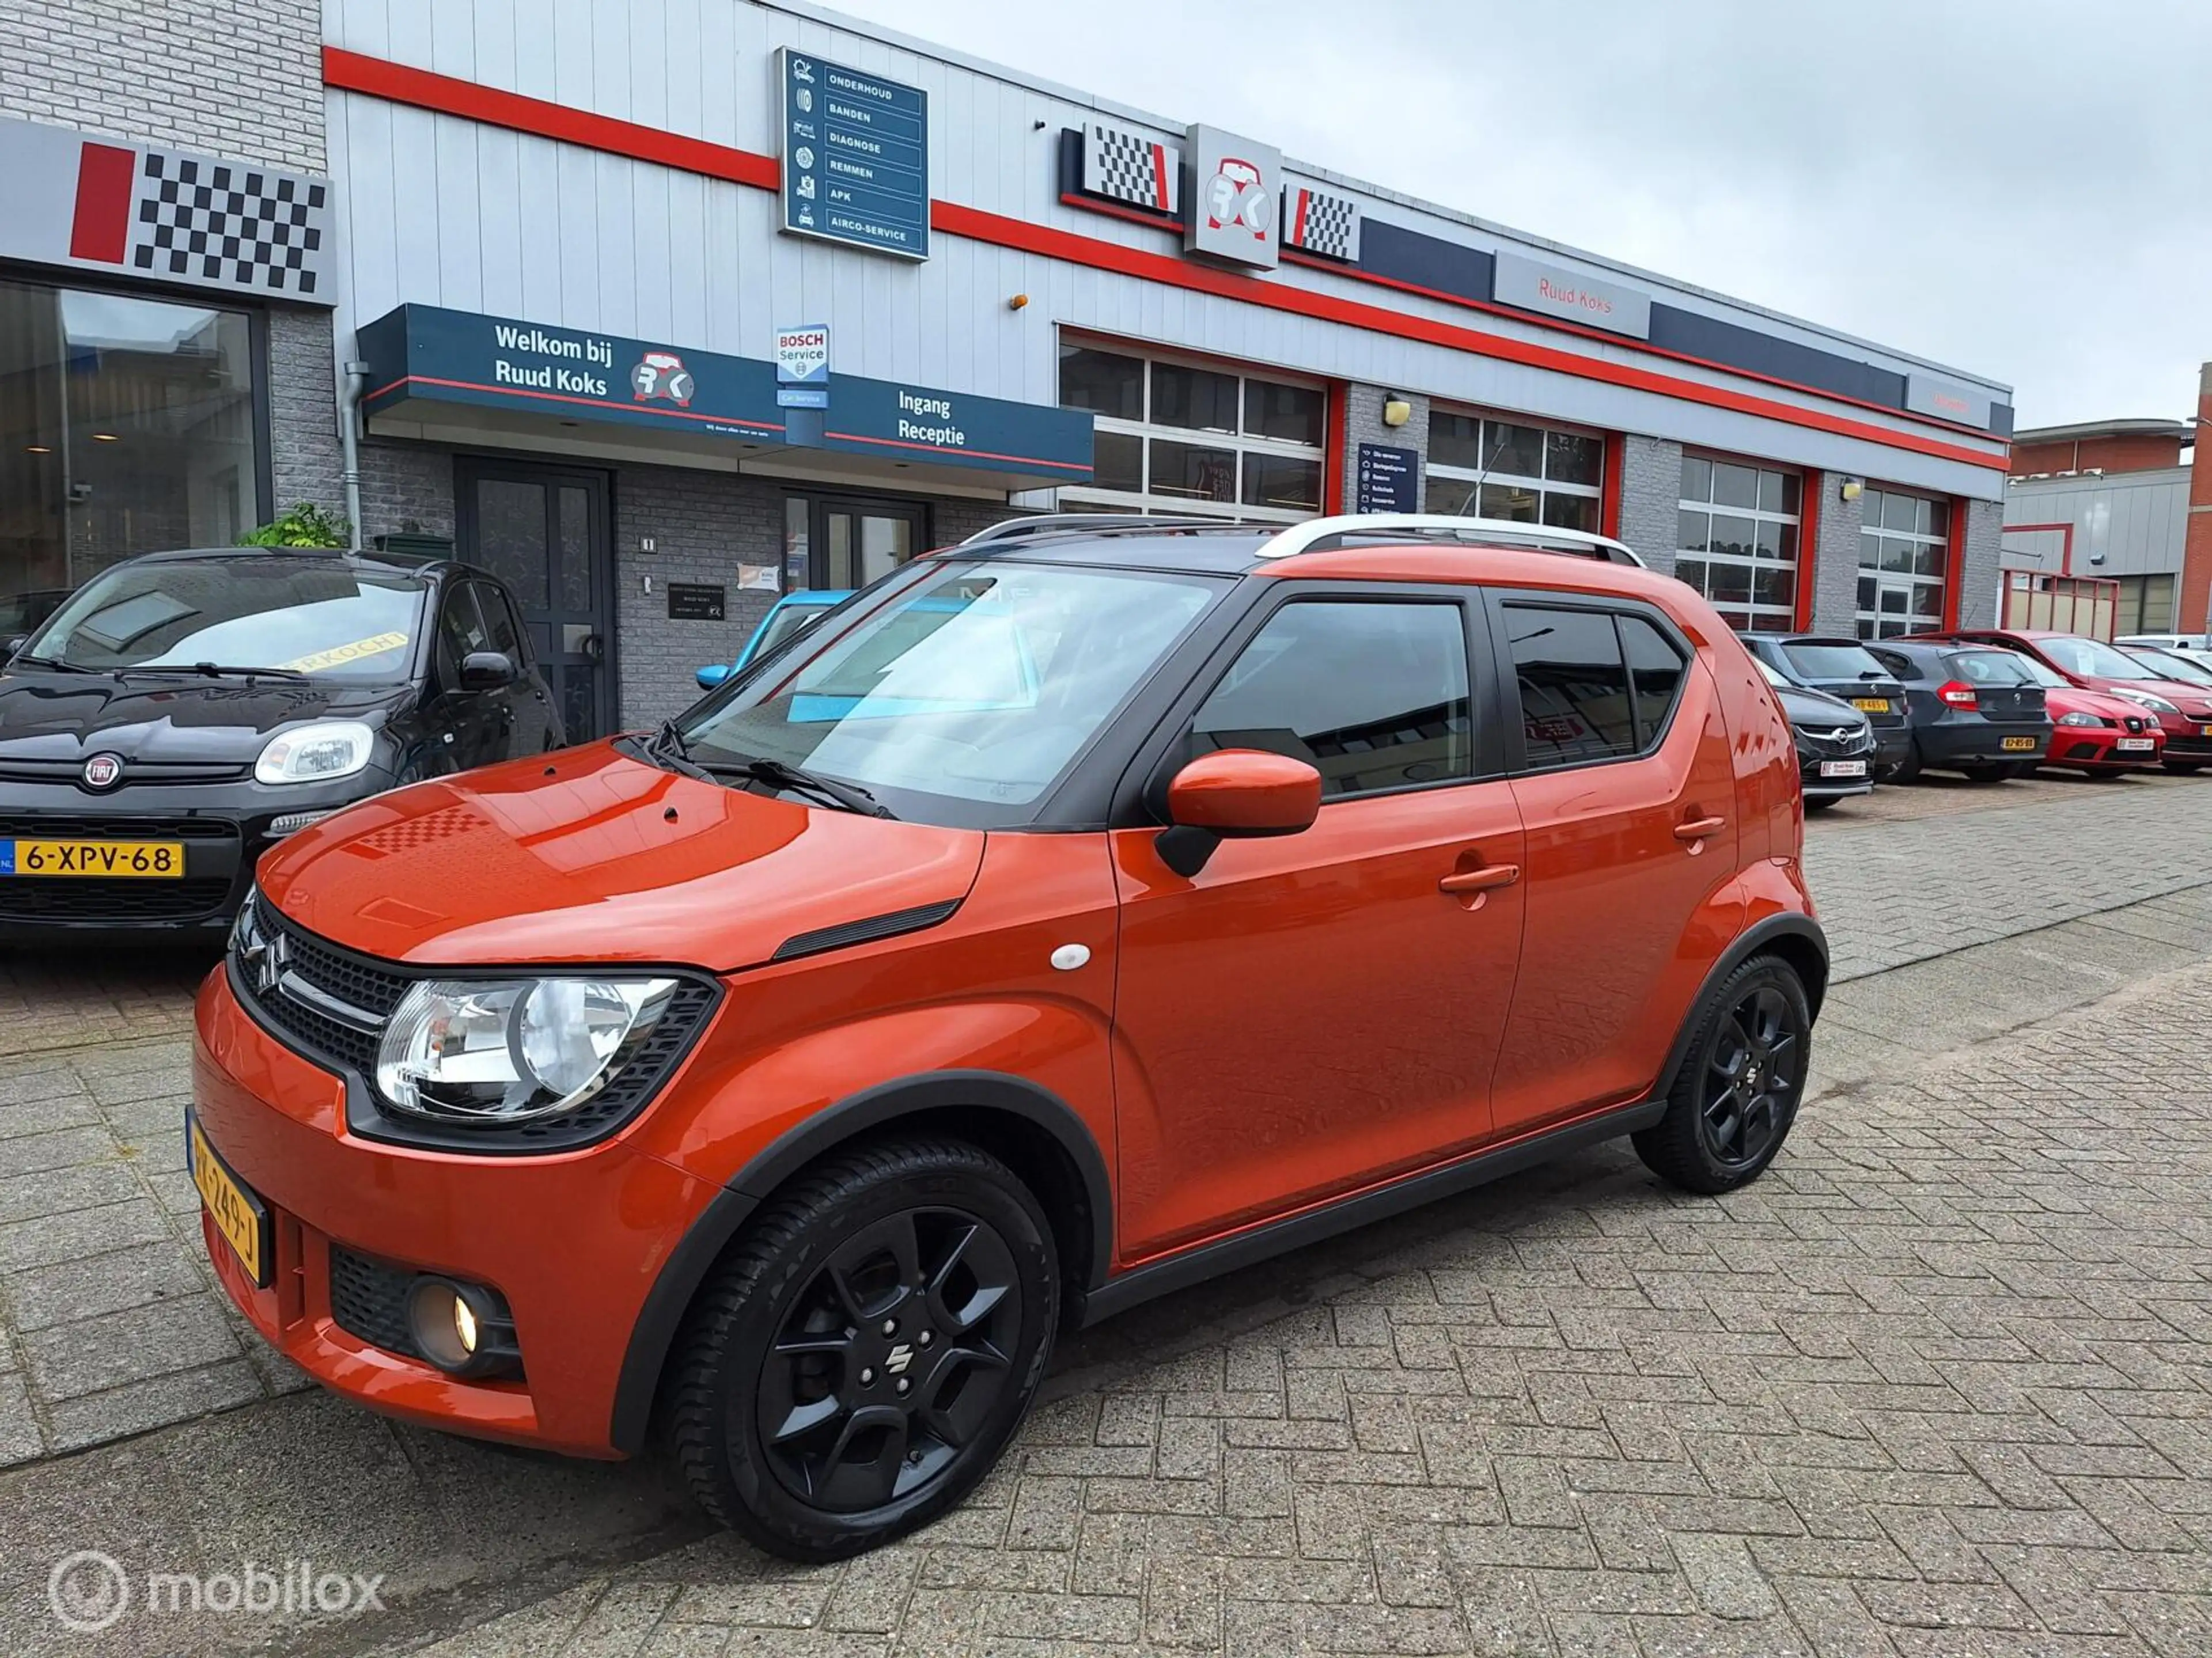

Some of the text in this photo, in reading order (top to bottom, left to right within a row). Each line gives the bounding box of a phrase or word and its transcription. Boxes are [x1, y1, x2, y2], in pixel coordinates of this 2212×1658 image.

[830, 74, 892, 100] ONDERHOUD
[830, 104, 870, 123] BANDEN
[830, 133, 881, 154] DIAGNOSE
[830, 160, 873, 179] REMMEN
[830, 191, 851, 202] APK
[831, 217, 906, 241] AIRCO-SERVICE
[1539, 278, 1612, 314] Ruud Koks
[495, 325, 612, 369] Welkom bij
[780, 333, 824, 347] BOSCH
[780, 349, 824, 361] Service
[495, 361, 607, 396] Ruud Koks
[899, 390, 951, 419] Ingang
[899, 419, 965, 446] Receptie
[92, 765, 114, 778] FIAT
[26, 845, 172, 872] 6-XPV-68
